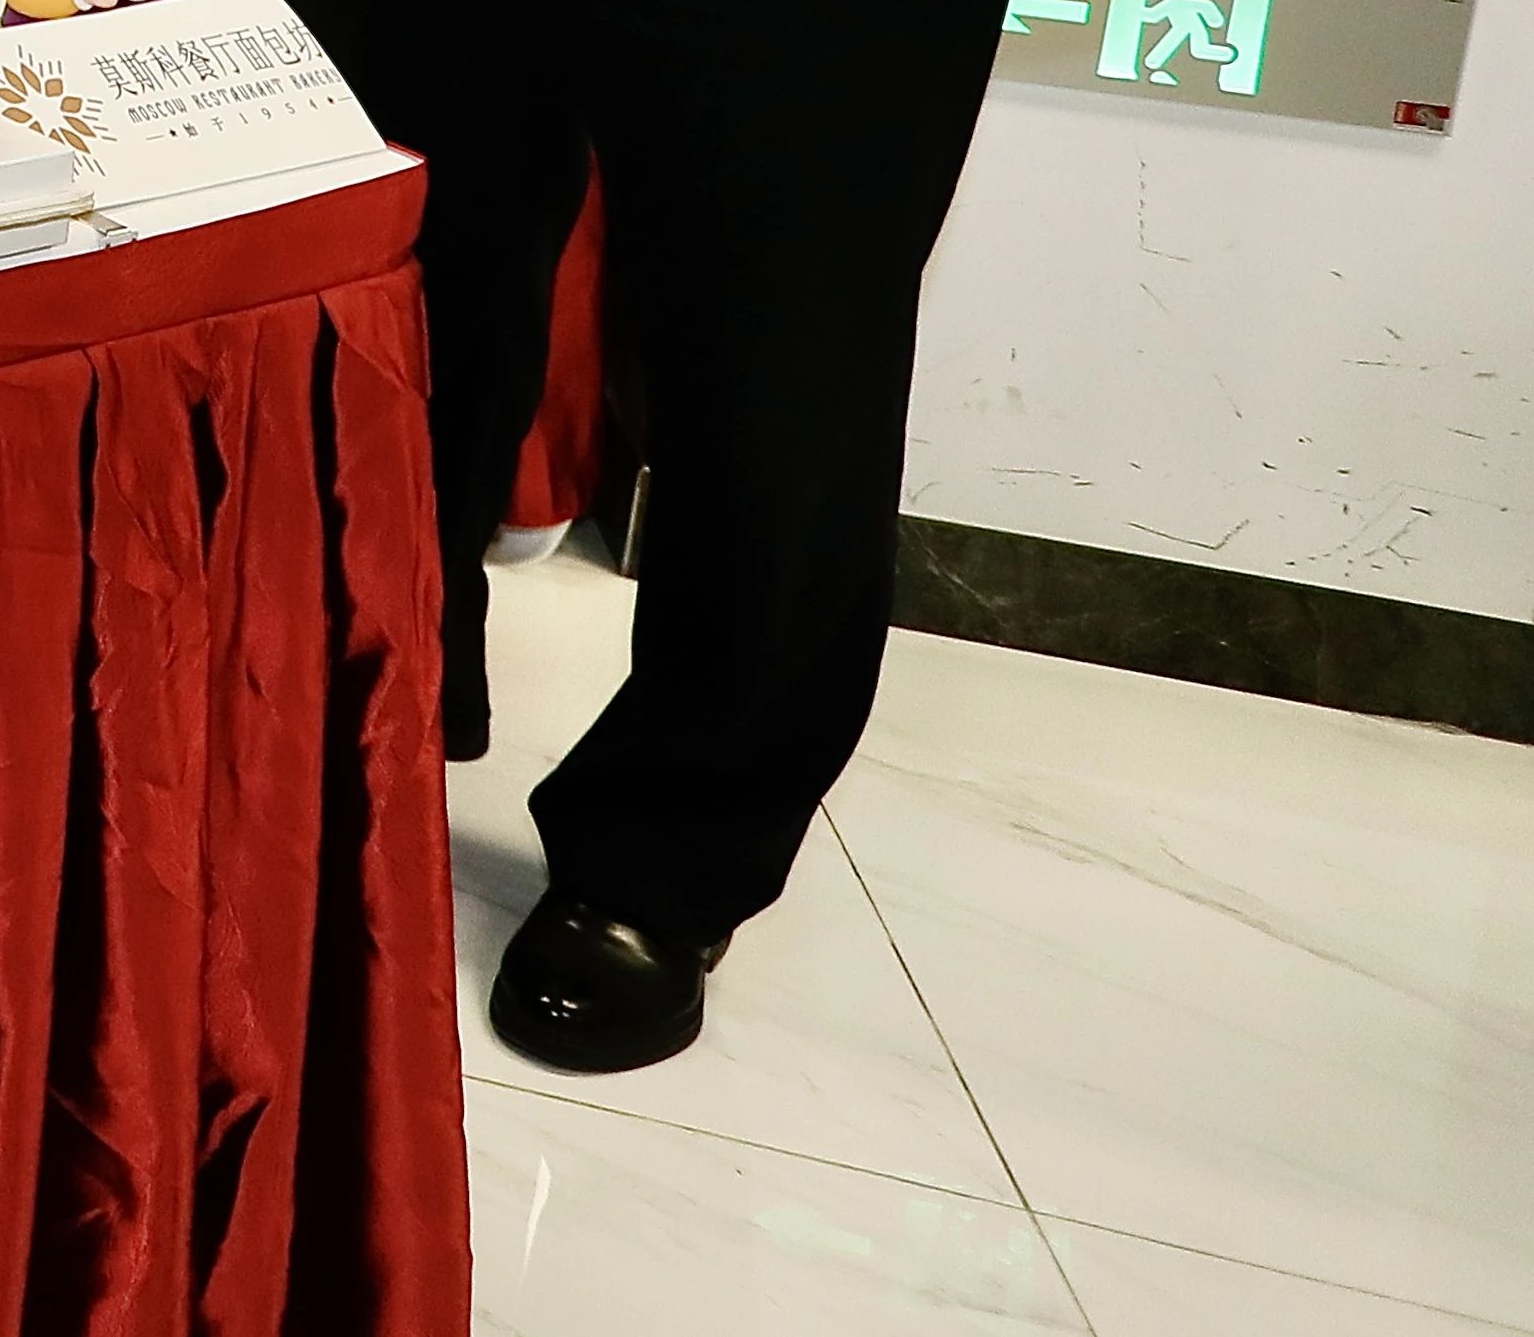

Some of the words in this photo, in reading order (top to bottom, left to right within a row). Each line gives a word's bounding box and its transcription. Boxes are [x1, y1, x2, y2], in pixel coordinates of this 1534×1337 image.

[91, 19, 324, 100] 莫斯科餐厅面包坊
[127, 96, 189, 125] MOSCOW
[192, 76, 286, 110] RESTAURANT
[289, 67, 342, 92] BAKERY
